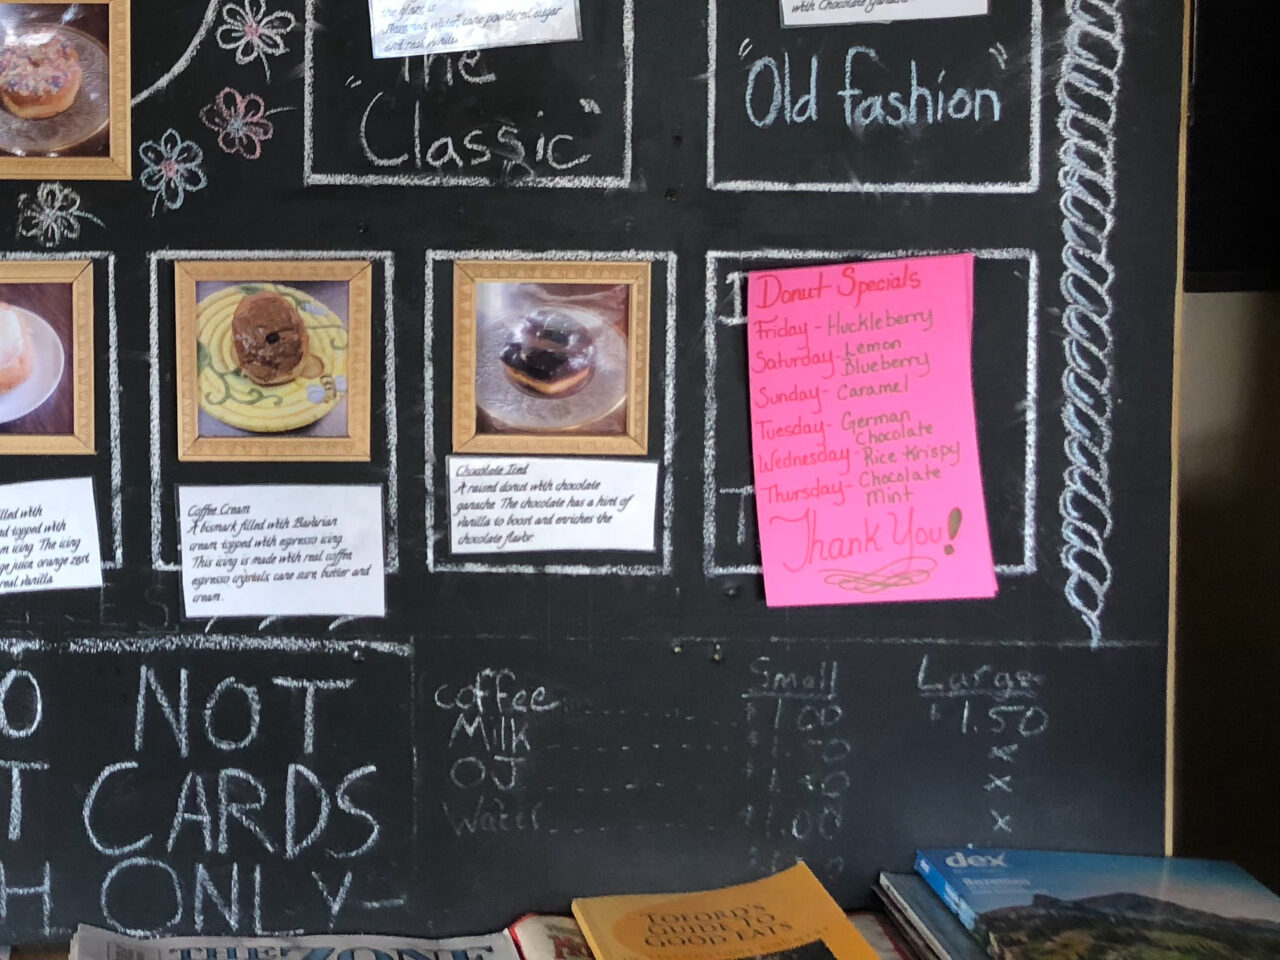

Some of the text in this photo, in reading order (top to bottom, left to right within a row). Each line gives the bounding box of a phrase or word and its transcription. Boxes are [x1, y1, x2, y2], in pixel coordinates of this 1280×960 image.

[756, 265, 922, 309] Donut Specials
[841, 352, 931, 378] Blueberry
[837, 374, 908, 402] Caramel
[841, 409, 911, 432] German
[855, 421, 934, 446] Chocolate
[863, 444, 897, 469] Rice
[456, 464, 503, 477] Chocolate
[858, 466, 942, 489] Chocolate
[769, 508, 883, 572] Thank
[136, 664, 356, 758] NOT
[449, 713, 531, 750] Milk
[450, 755, 523, 790] OJ
[83, 762, 381, 859] CARDS
[945, 851, 1008, 868] dex
